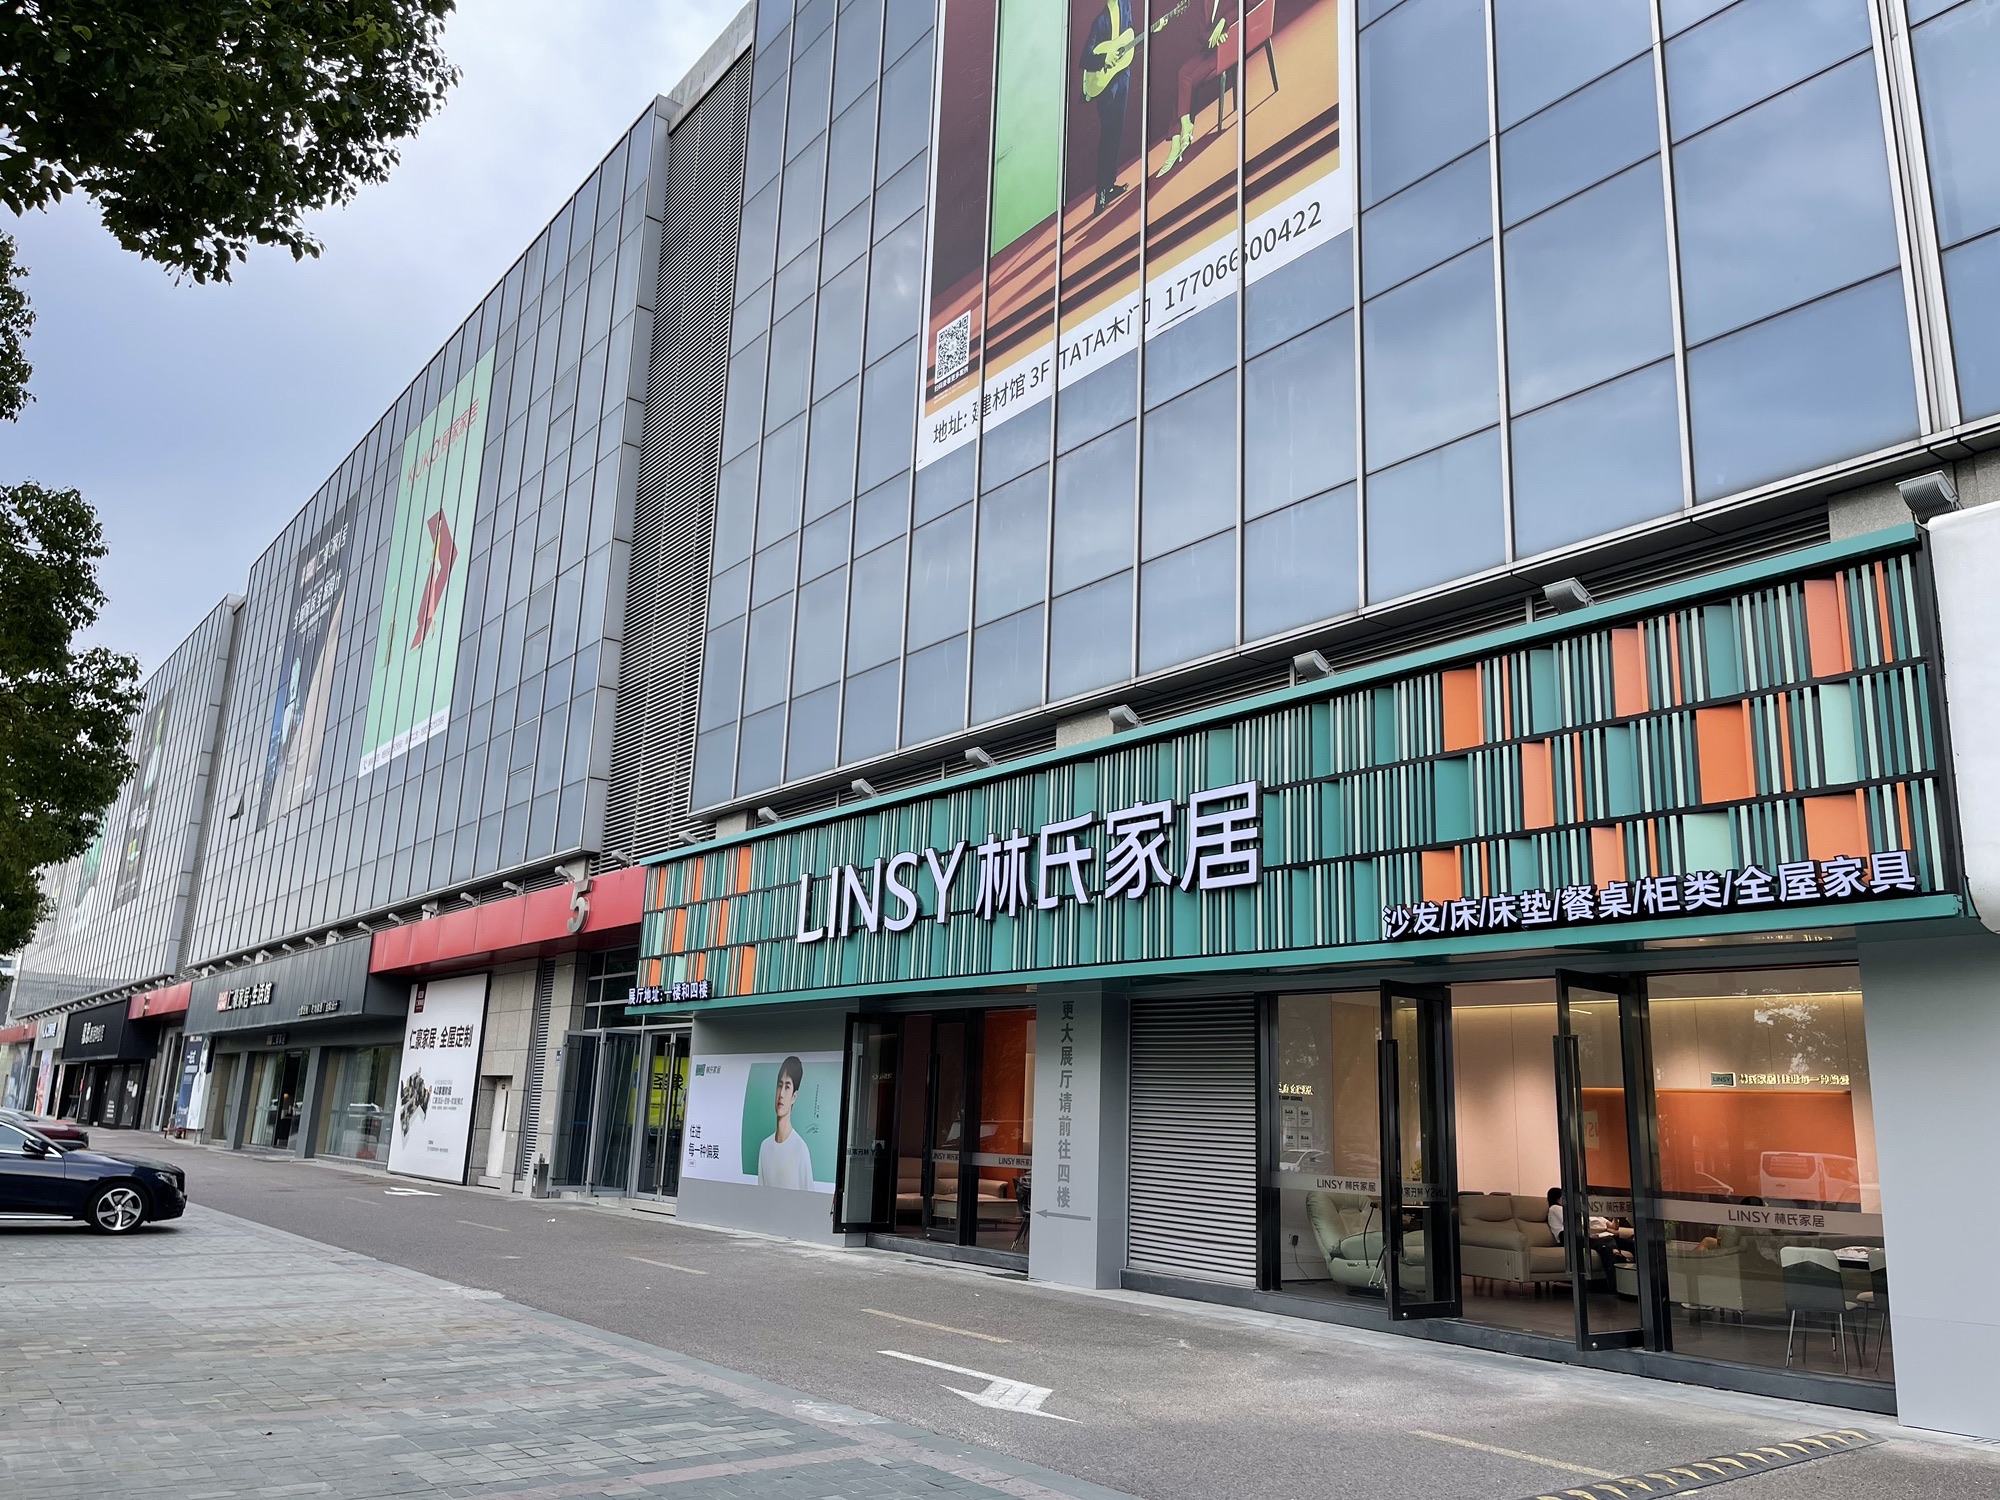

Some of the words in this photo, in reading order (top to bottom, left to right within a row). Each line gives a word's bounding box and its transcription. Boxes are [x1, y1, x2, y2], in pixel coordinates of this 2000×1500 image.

[1030, 359, 1050, 389] 3F
[1059, 297, 1151, 370] TATA木门
[797, 840, 968, 943] LINSY
[975, 780, 1262, 922] 林氏家居
[1382, 850, 1917, 940] 沙发/床/床垫/餐桌/柜类/全屋家具
[566, 880, 593, 935] 5
[1713, 1075, 1731, 1083] LINSY
[1056, 1001, 1075, 1209] 更大展厅请前往四楼
[689, 1142, 720, 1160] 每一种偏爱
[998, 1157, 1015, 1165] LINSY
[1316, 1179, 1343, 1190] LINSY
[1345, 1181, 1376, 1192] 林氏家居
[1587, 1201, 1604, 1213] NSY
[1605, 1201, 1632, 1213] 林氏家居
[1728, 1209, 1770, 1224] LINSY
[1774, 1212, 1825, 1228] 林氏家居
